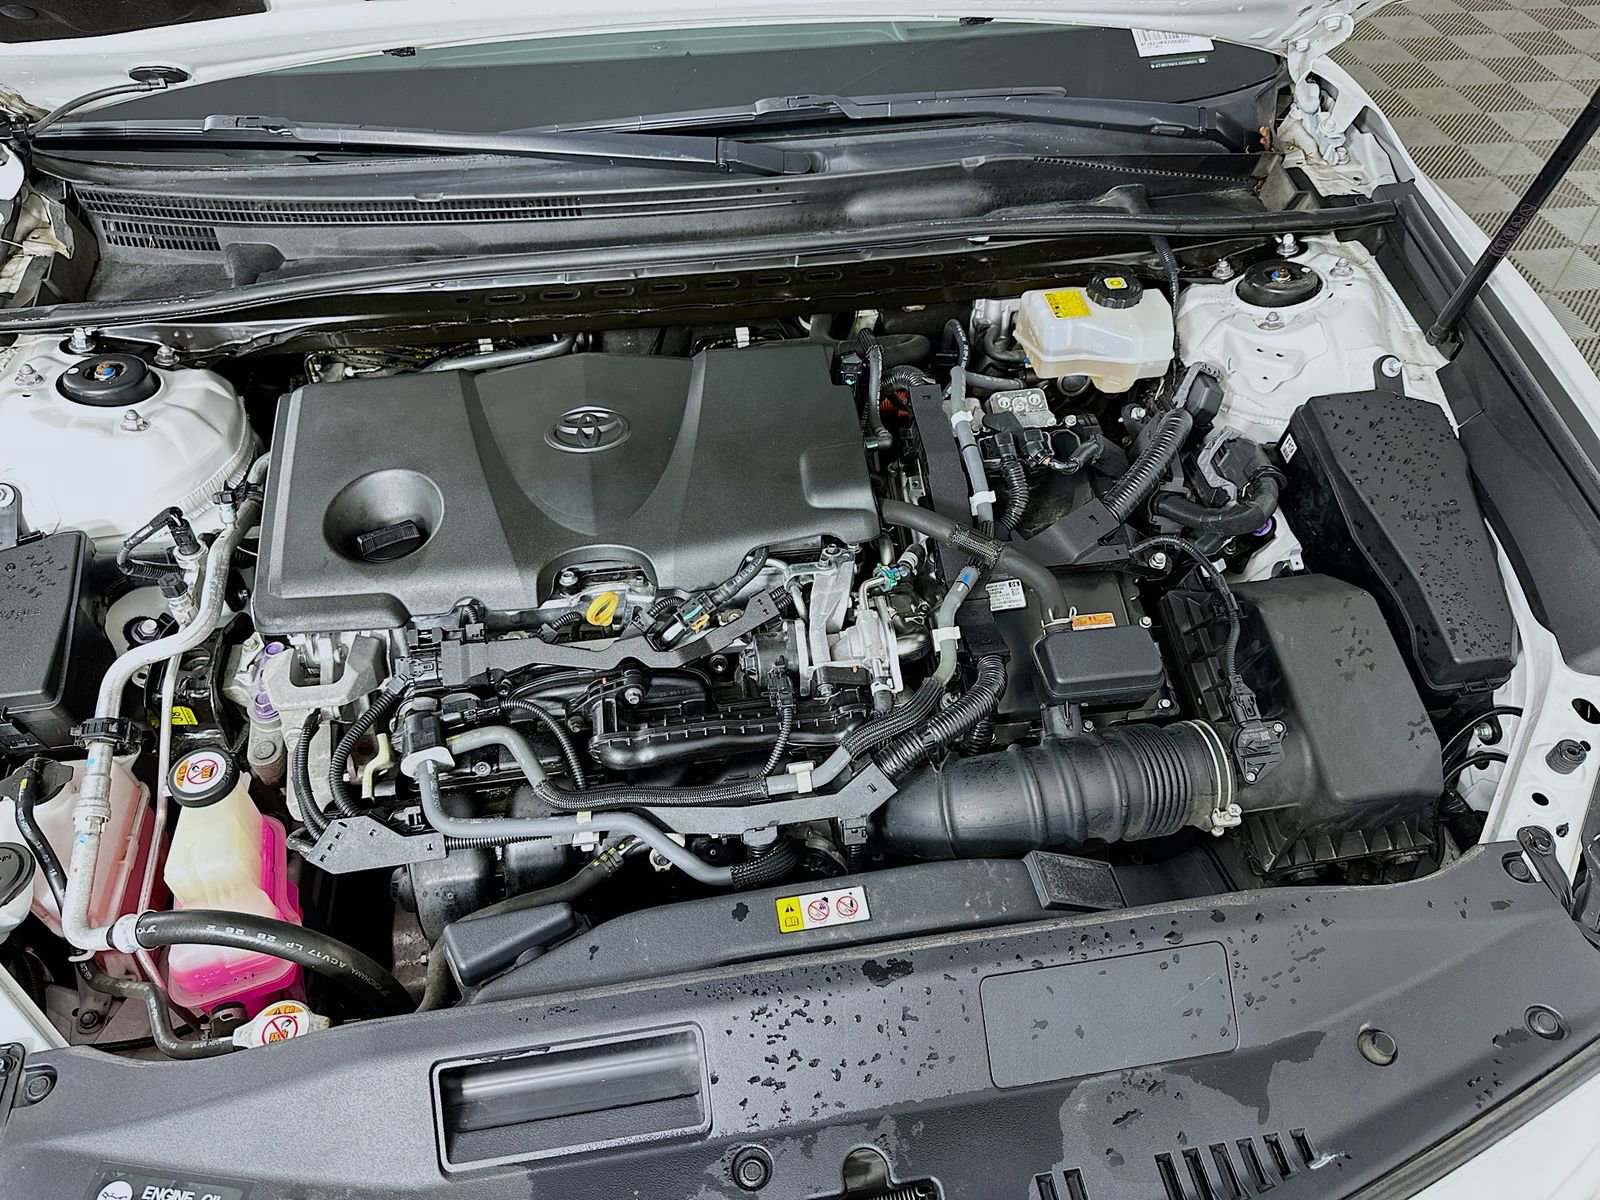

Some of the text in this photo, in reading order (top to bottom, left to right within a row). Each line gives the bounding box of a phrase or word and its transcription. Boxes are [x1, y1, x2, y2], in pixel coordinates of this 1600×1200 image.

[285, 941, 304, 952] LP
[307, 948, 347, 969] ACV17
[141, 1186, 195, 1200] ENGINE
